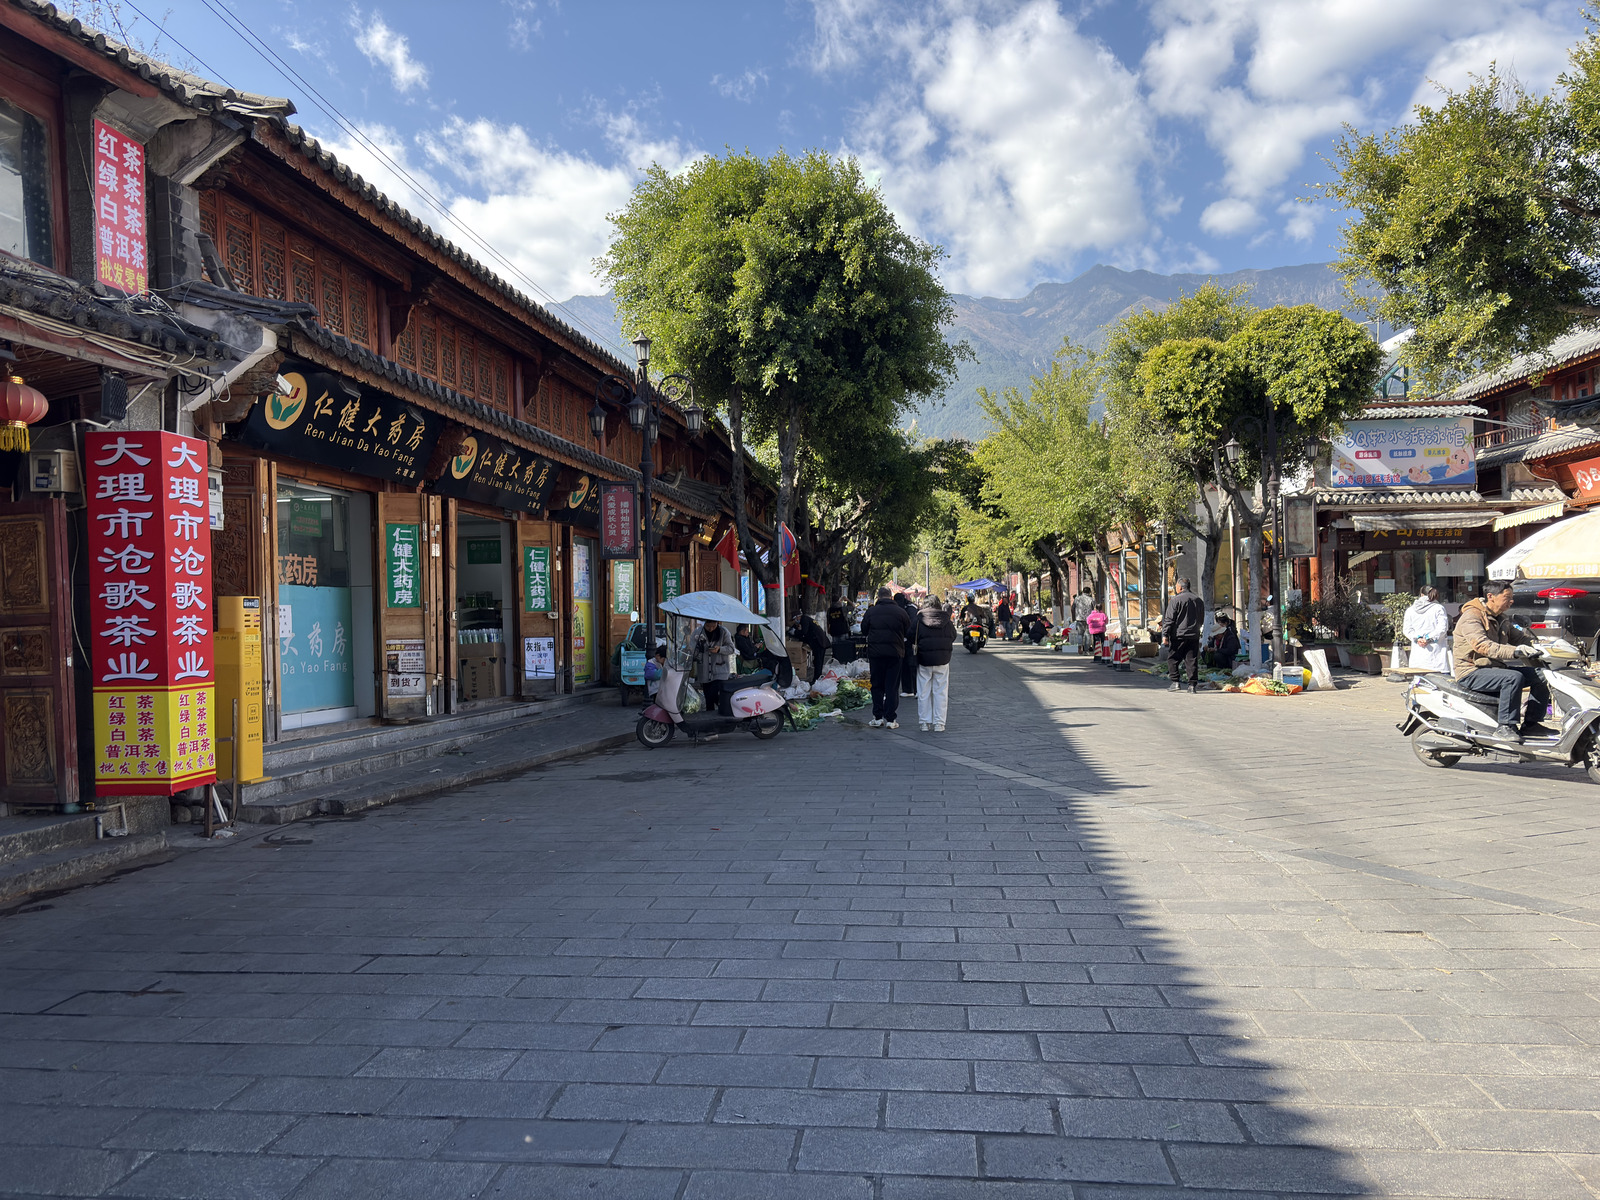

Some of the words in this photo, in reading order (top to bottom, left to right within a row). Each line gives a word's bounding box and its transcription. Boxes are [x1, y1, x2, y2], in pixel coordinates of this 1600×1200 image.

[99, 128, 142, 174] 红茶
[98, 160, 142, 205] 绿茶
[100, 194, 142, 236] 白茶
[99, 225, 145, 269] 普洱茶
[101, 257, 146, 295] 批发零售
[313, 389, 426, 451] 仁健大药房
[304, 423, 325, 439] Ren
[329, 431, 354, 447] Jian
[357, 438, 370, 452] Da
[374, 443, 390, 457] Yao
[392, 449, 415, 466] Fang
[473, 472, 486, 484] Ren
[487, 477, 503, 488] Jian
[504, 481, 512, 490] Da
[514, 483, 525, 495] Yao
[526, 487, 541, 500] Fang
[479, 447, 549, 488] 仁健大药房
[94, 437, 158, 682] 大理市沧歌茶业
[167, 441, 209, 681] 大理市沧歌茶业
[393, 527, 413, 604] 仁健大药房
[529, 549, 546, 609] 仁健大药房
[618, 562, 630, 613] 仁健大药房
[281, 621, 347, 658] 大药房
[282, 662, 295, 675] Da
[300, 661, 319, 673] Yao
[324, 660, 348, 673] Fang
[391, 677, 420, 687] 到货了
[109, 695, 154, 709] 红茶
[179, 691, 207, 707] 红茶
[179, 707, 207, 723] 绿茶
[109, 711, 154, 726] 绿茶
[111, 728, 155, 742] 白茶
[180, 722, 207, 739] 白茶
[105, 744, 160, 758] 普洱茶
[174, 752, 215, 773] 批发零售
[177, 738, 211, 756] 普洱茶
[99, 760, 168, 776] 批发零售
